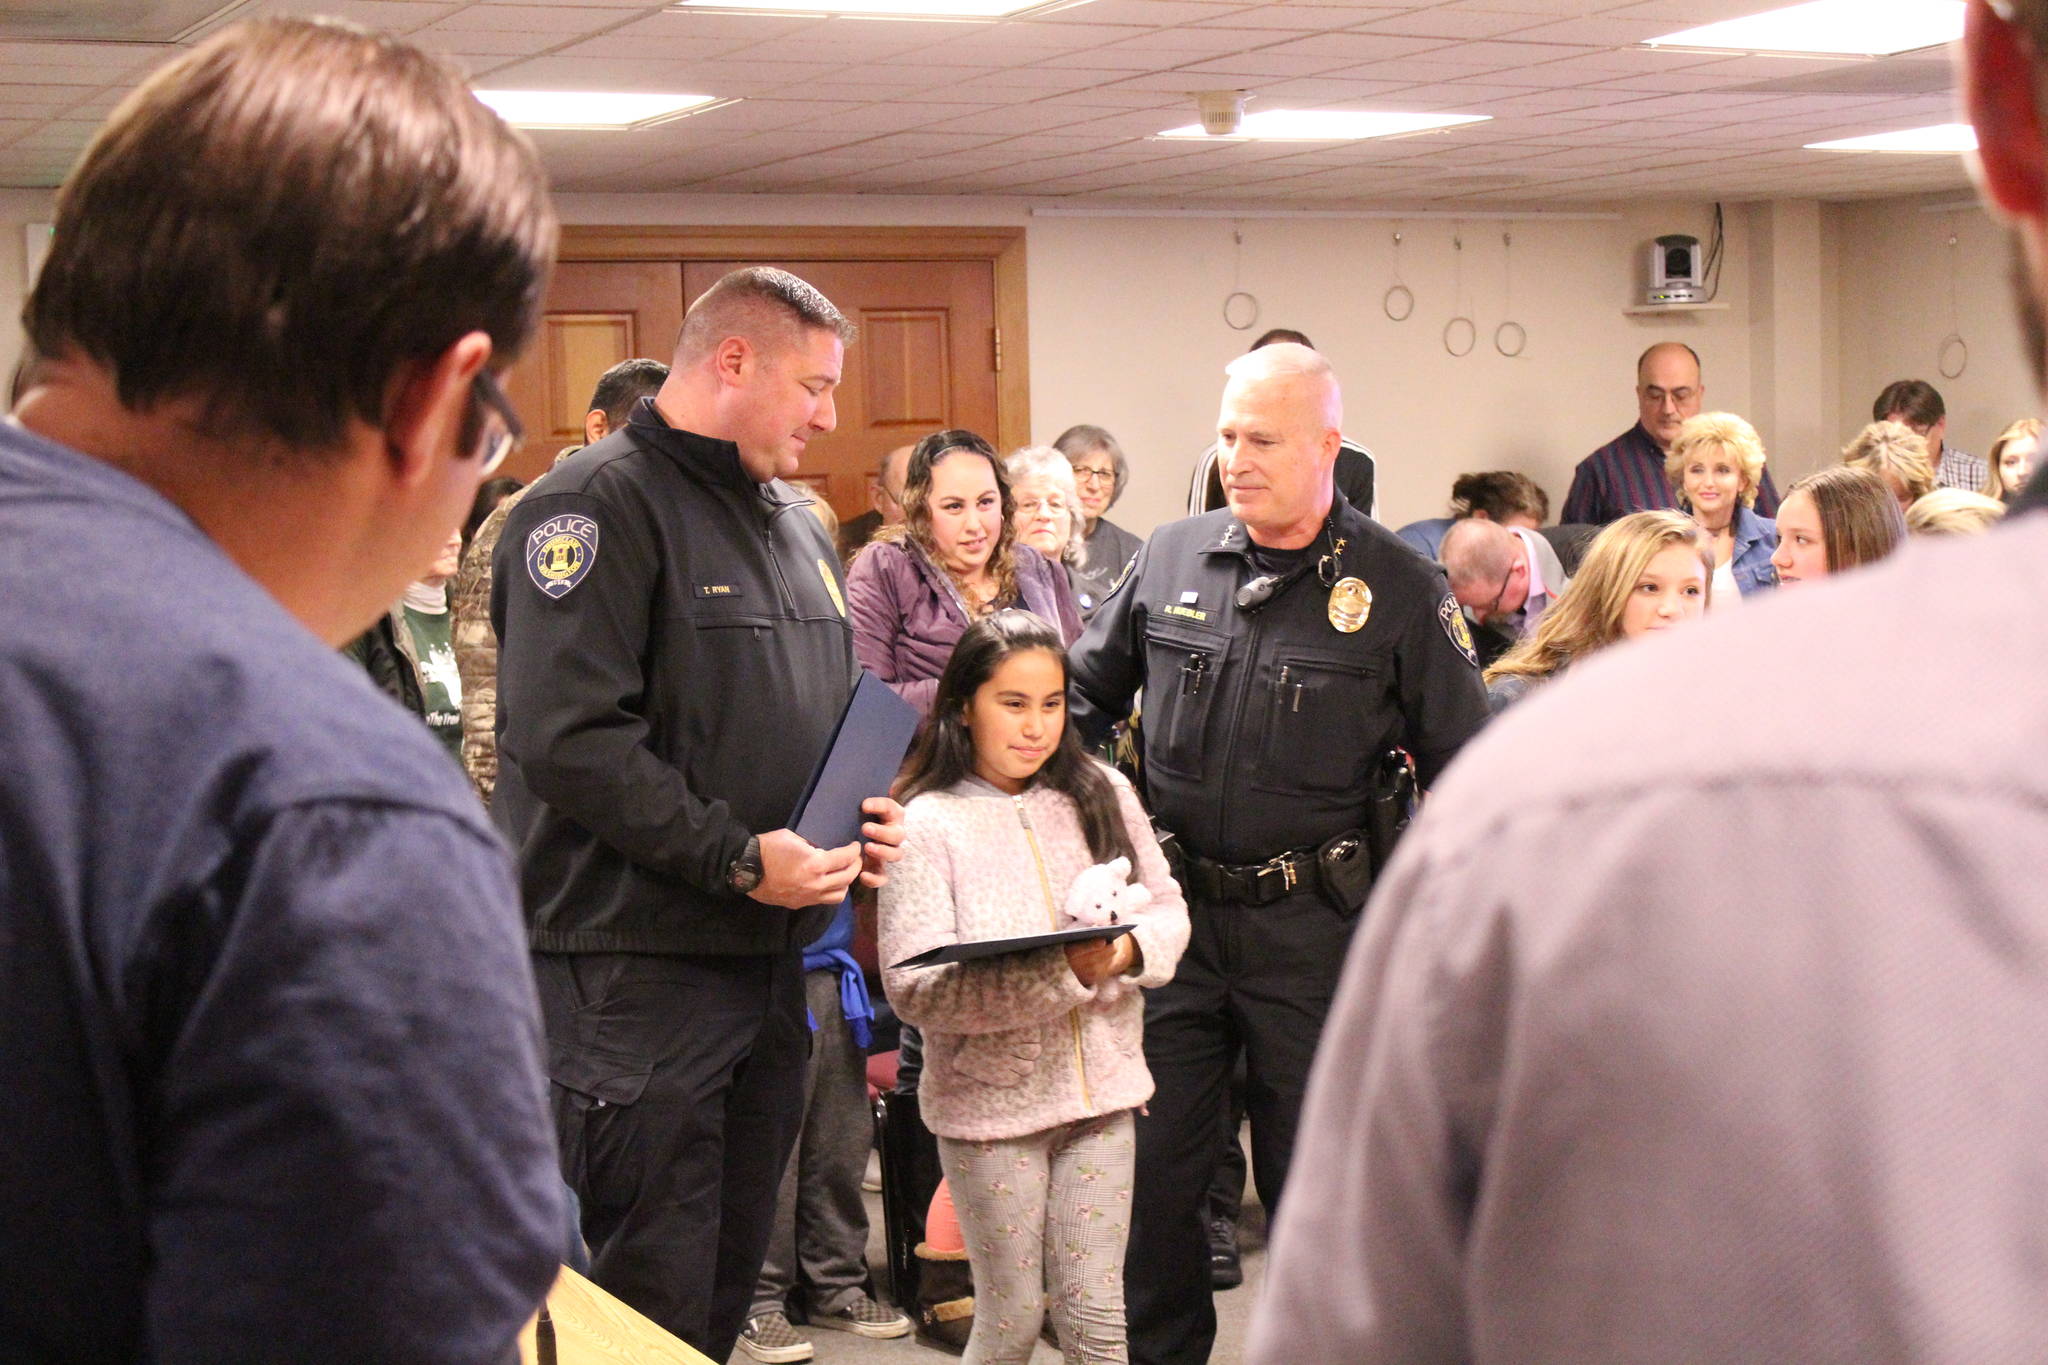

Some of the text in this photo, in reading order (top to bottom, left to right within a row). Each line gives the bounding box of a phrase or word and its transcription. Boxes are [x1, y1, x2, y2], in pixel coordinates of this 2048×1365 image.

[532, 518, 596, 545] POLICE
[711, 585, 731, 594] RYAN
[1440, 595, 1460, 621] POLI
